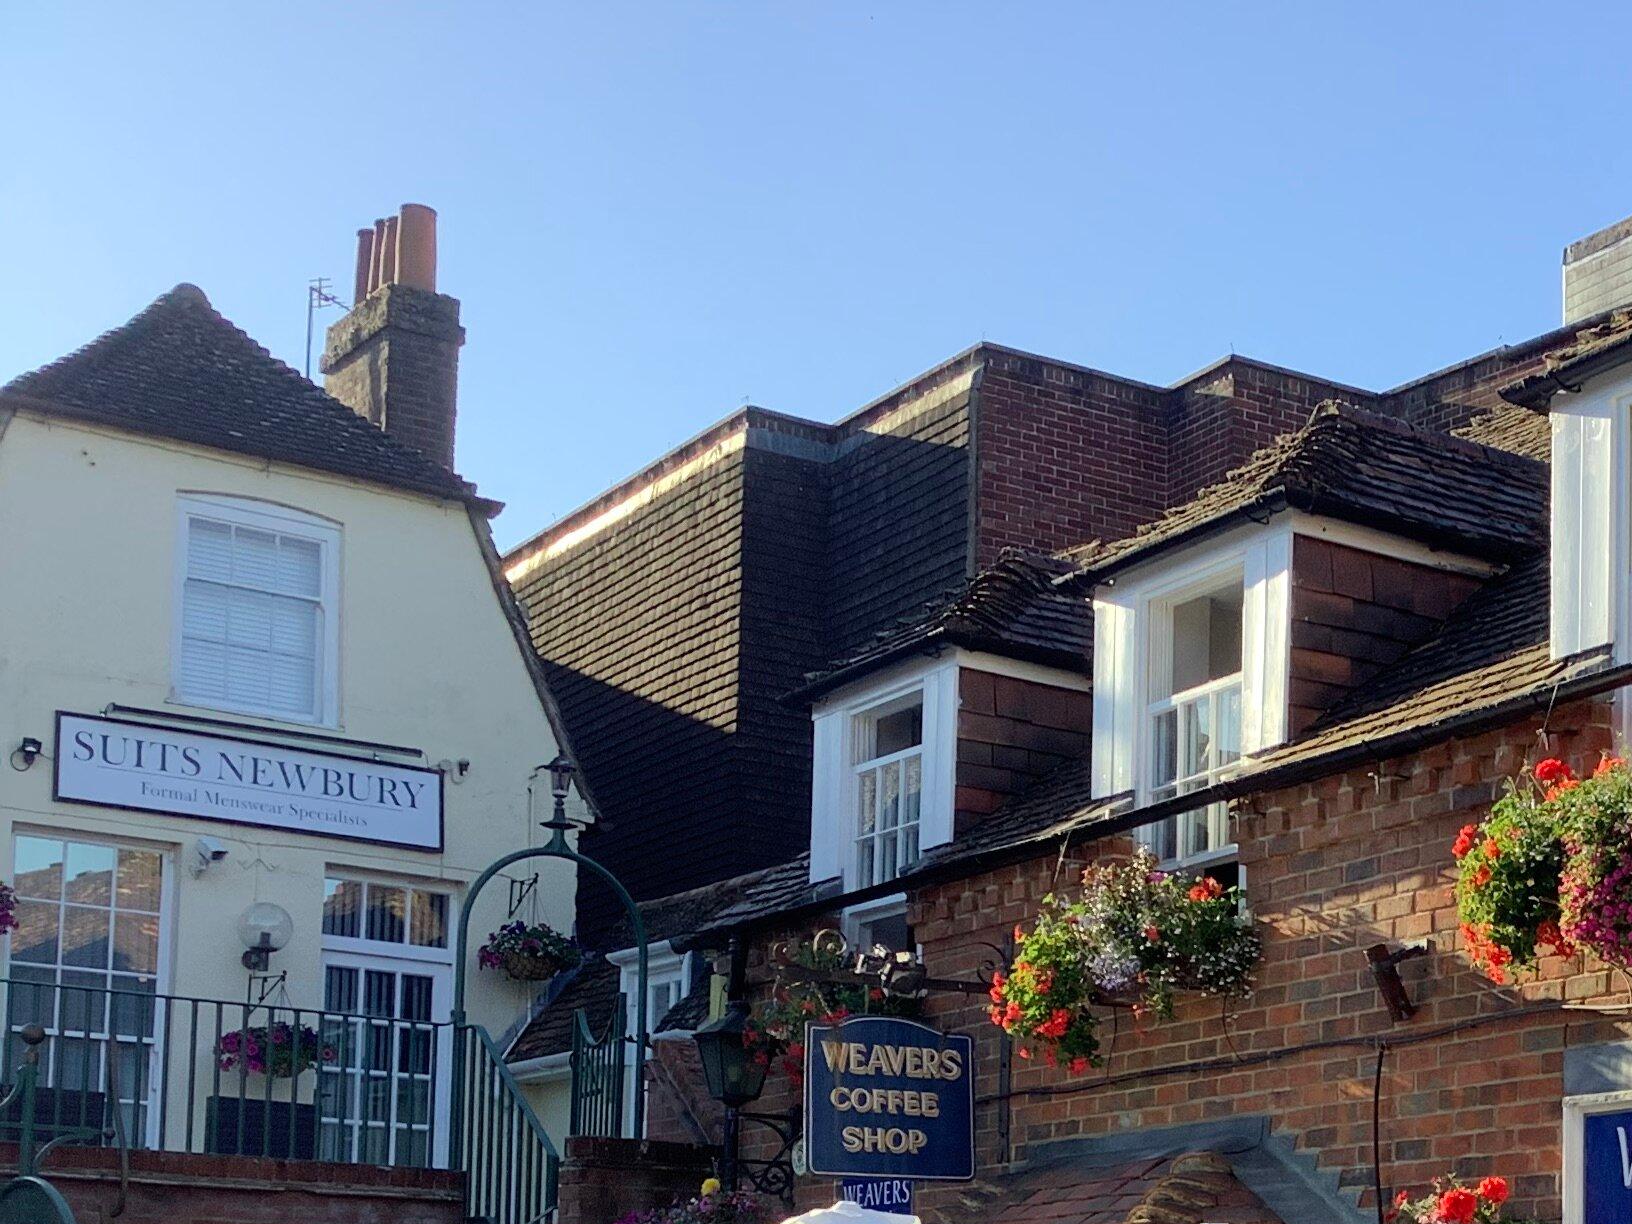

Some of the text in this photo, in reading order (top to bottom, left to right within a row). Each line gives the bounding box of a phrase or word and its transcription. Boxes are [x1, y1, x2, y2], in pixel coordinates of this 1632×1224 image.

[73, 730, 425, 810] SUITS NEWBURY
[141, 781, 369, 828] Formal Menswear Specialists
[820, 1040, 963, 1081] WEAVERS
[830, 1086, 940, 1118] COFFEE
[842, 1126, 928, 1154] SHOP
[843, 1180, 911, 1207] WEAVERS
